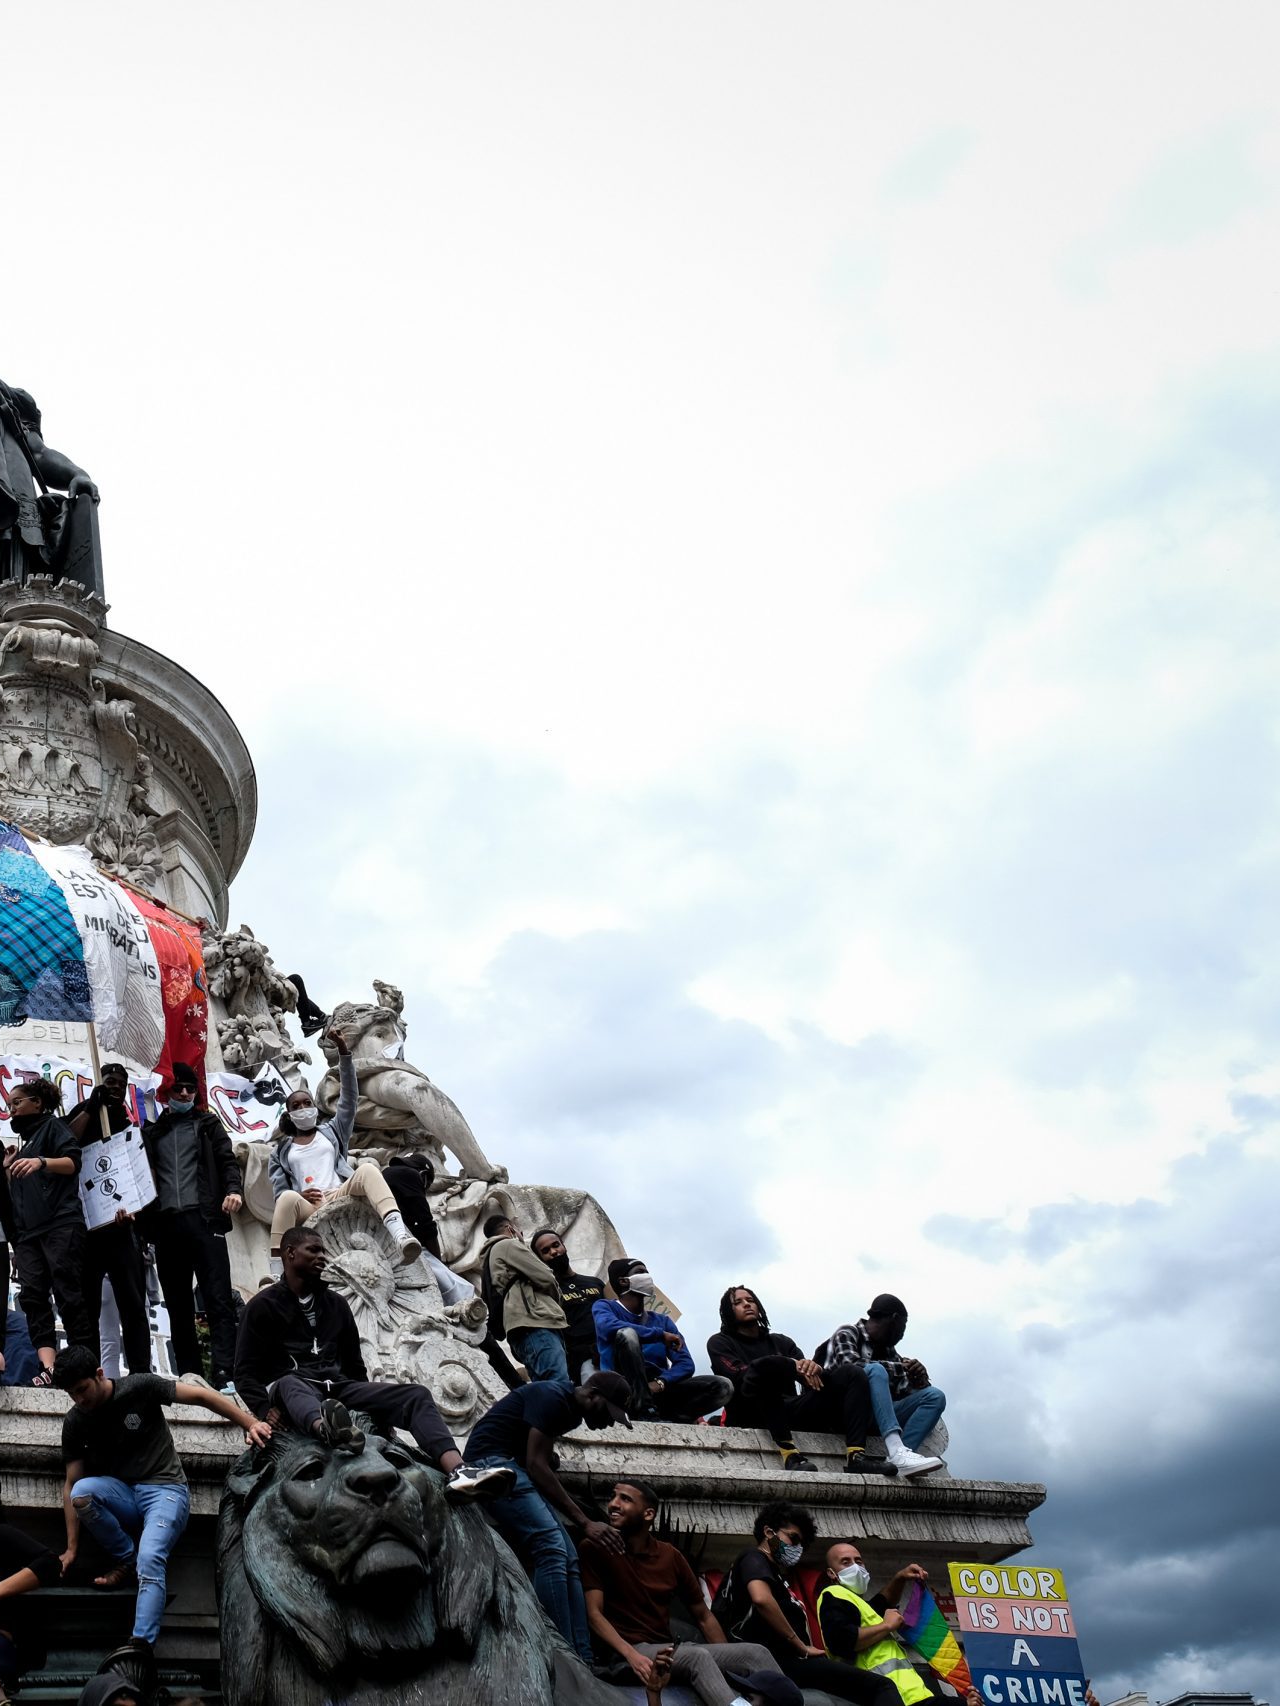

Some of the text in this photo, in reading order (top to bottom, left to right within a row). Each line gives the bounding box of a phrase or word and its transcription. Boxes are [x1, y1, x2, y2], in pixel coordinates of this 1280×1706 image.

[56, 868, 86, 881] LA
[71, 883, 108, 900] EST
[32, 1025, 62, 1040] DE
[959, 1569, 1062, 1599] COLOR
[968, 1601, 1070, 1633] IS NOT
[1011, 1638, 1040, 1667] A
[983, 1674, 1086, 1706] CRIME
